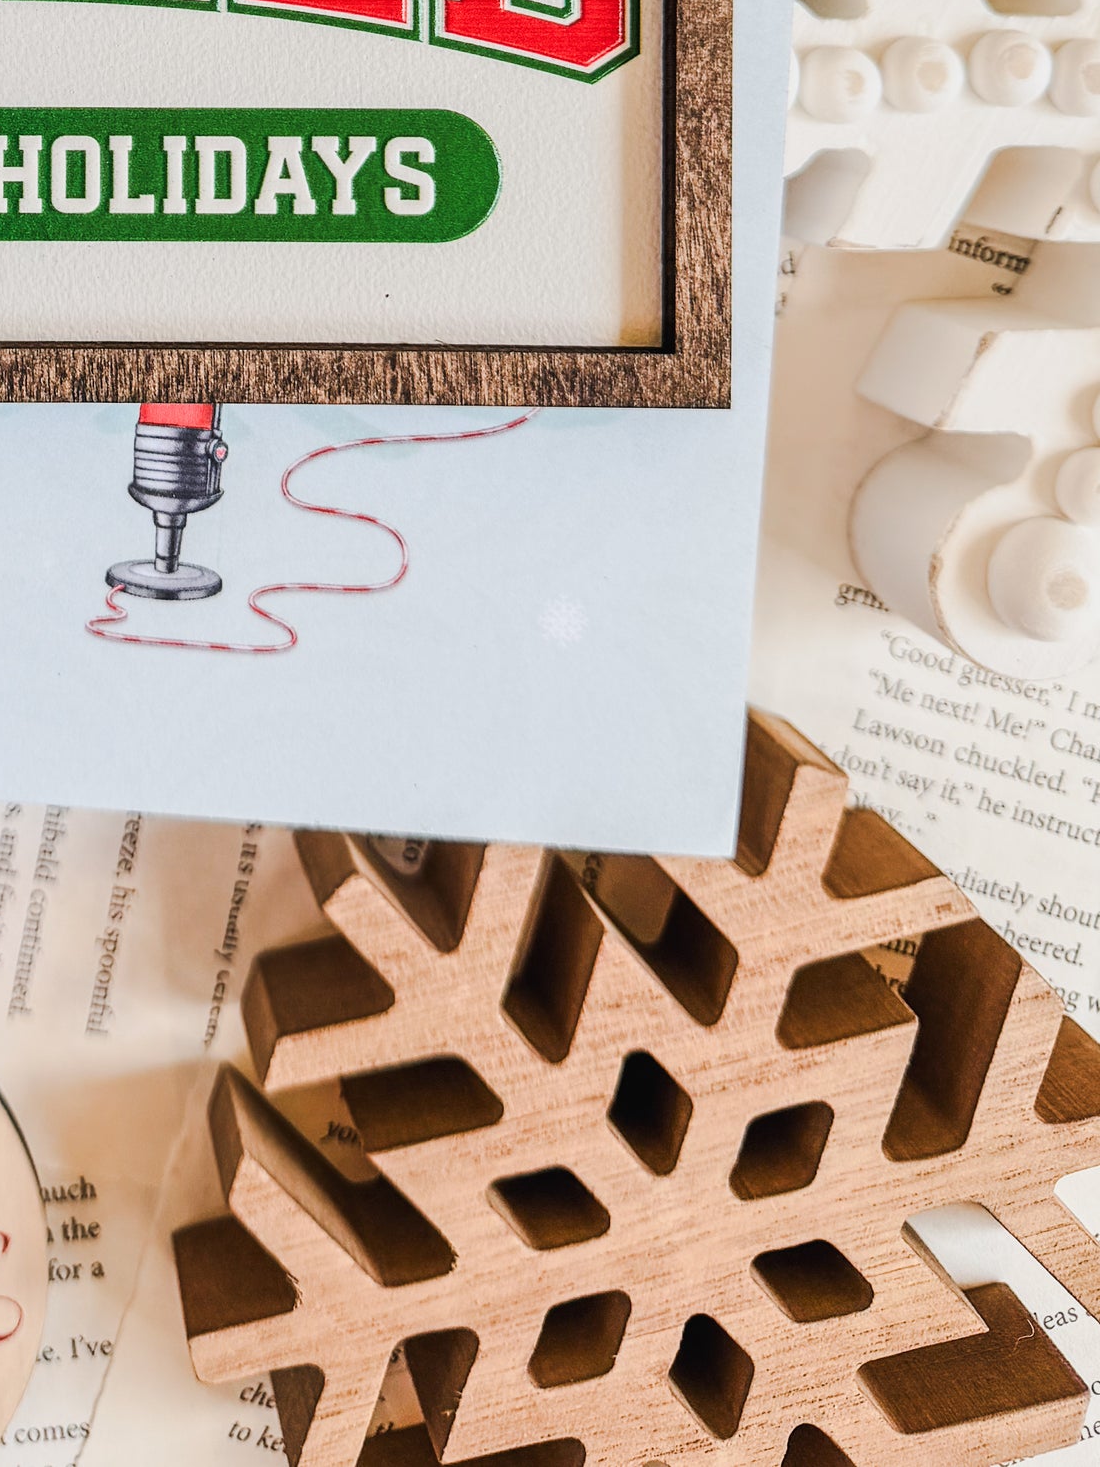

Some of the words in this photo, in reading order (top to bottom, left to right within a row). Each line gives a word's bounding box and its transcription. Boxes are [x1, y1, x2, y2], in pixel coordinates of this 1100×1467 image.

[921, 693, 979, 724] next!
[853, 708, 945, 755] Lawson
[953, 742, 1067, 794] chuckled.
[898, 770, 935, 799] say
[977, 791, 1006, 816] he
[108, 884, 136, 924] his
[85, 926, 124, 1038] spoonful
[61, 1216, 101, 1242] the
[91, 1261, 105, 1278] a
[70, 1334, 113, 1360] I've
